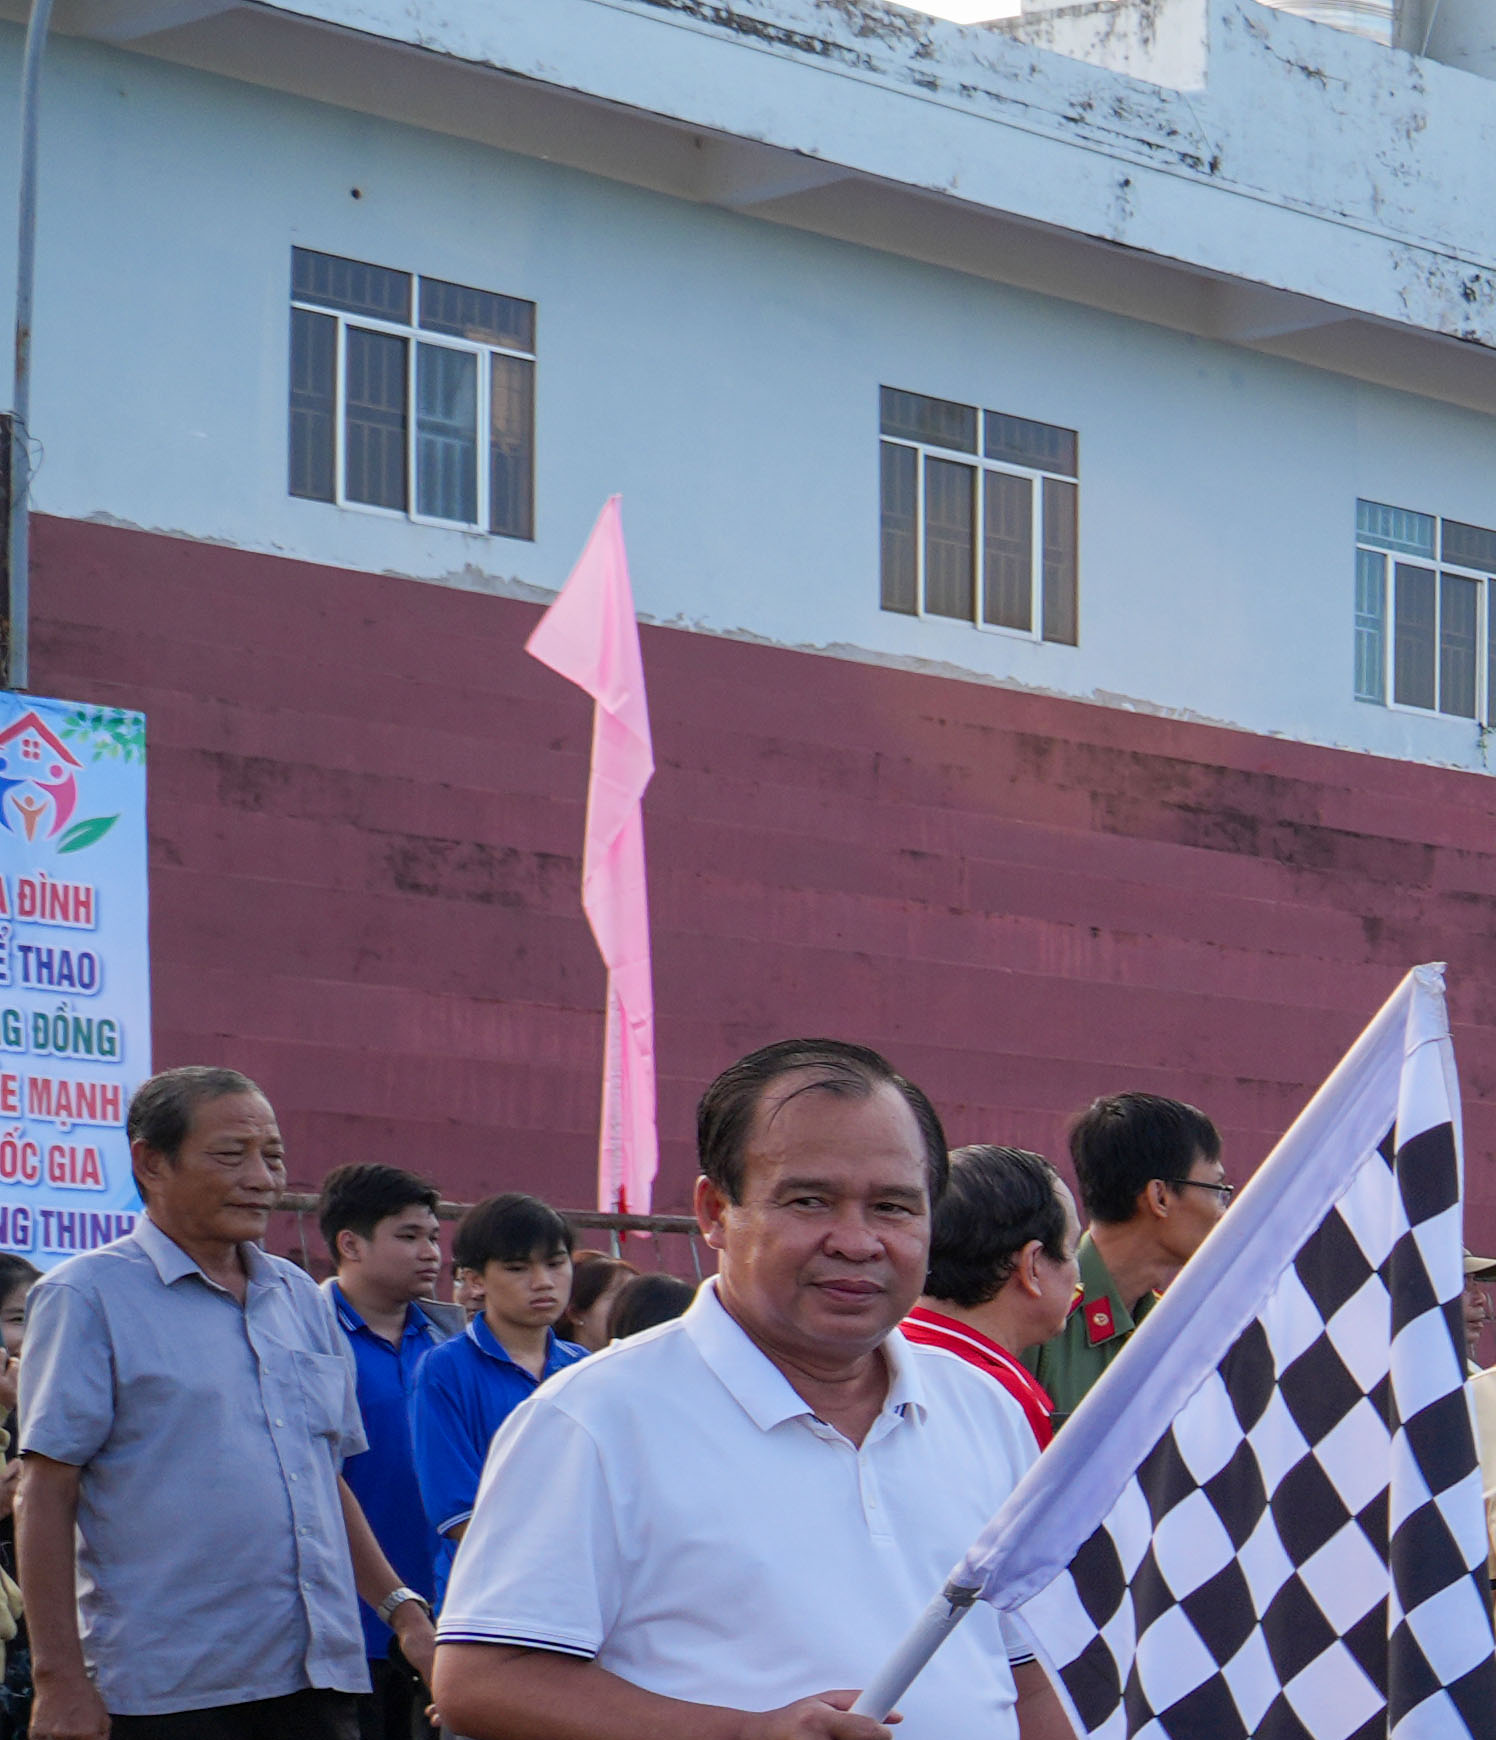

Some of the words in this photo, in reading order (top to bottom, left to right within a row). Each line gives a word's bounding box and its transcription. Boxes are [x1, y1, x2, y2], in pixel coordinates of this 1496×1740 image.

[17, 871, 93, 925] ĐÌNH
[17, 944, 96, 990] THAO
[32, 1001, 117, 1057] ĐỒNG
[28, 1077, 120, 1127] MẠNH
[0, 1126, 38, 1180] ỐC
[48, 1145, 103, 1185] GIA
